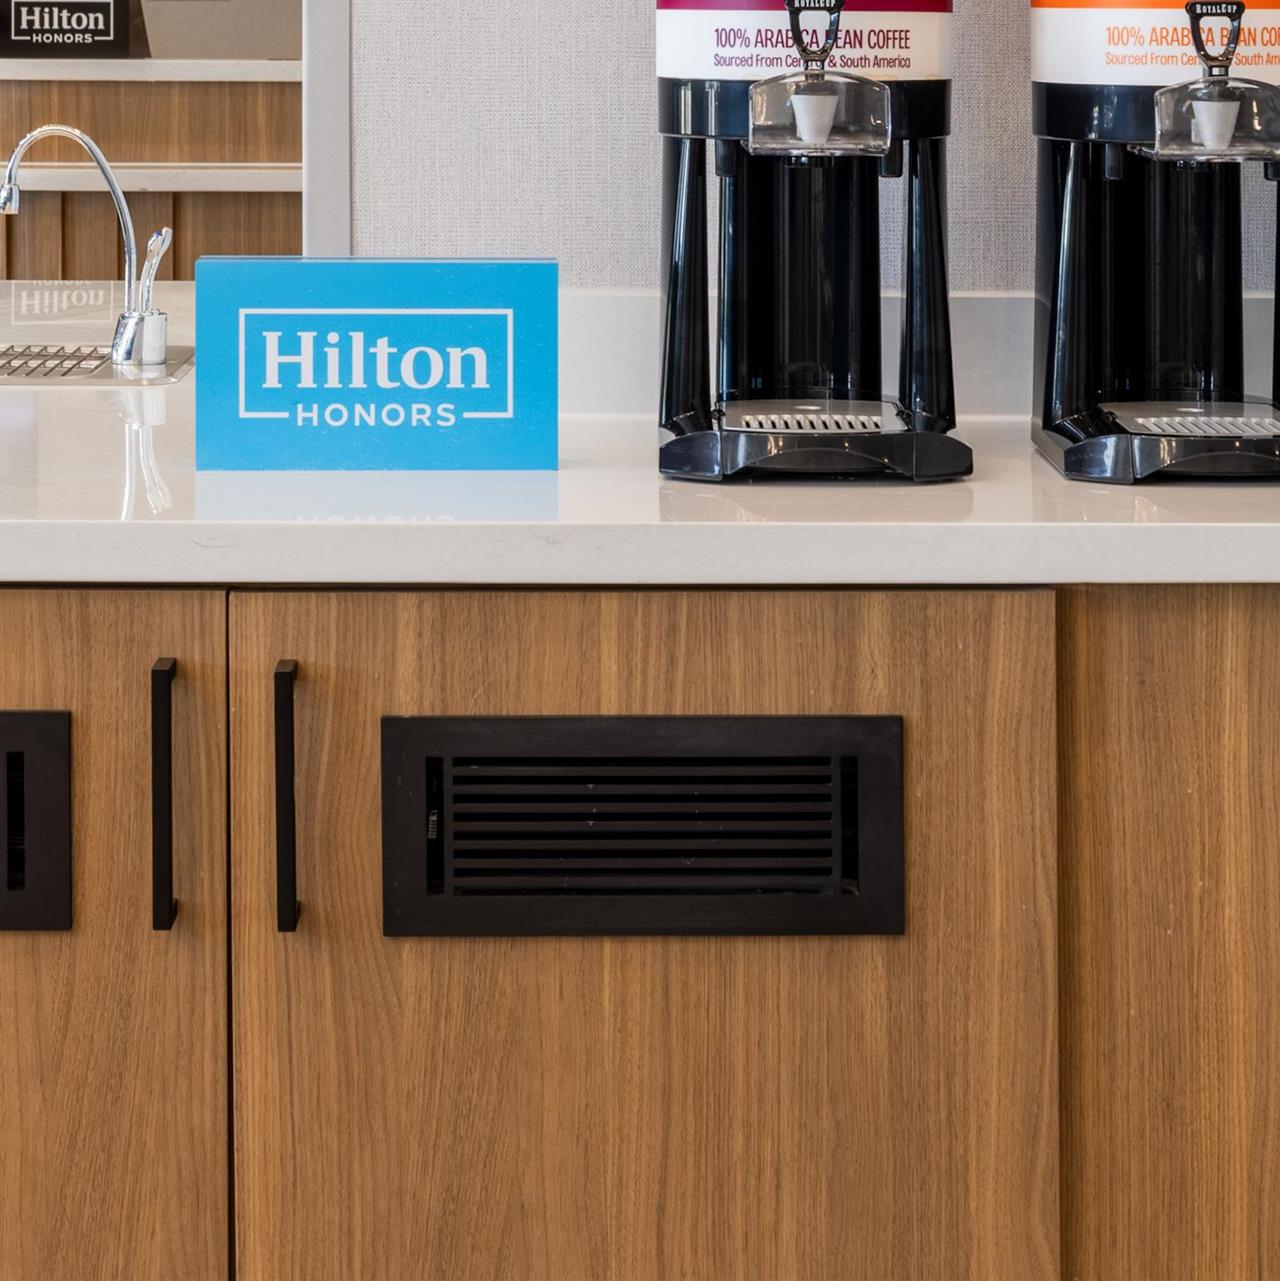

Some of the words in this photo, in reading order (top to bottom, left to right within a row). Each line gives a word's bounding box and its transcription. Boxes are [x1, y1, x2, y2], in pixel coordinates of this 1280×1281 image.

[19, 6, 106, 30] Hilton
[32, 33, 93, 43] HONORS
[713, 27, 751, 48] 100%
[754, 28, 820, 49] ARABCA
[867, 29, 911, 50] COFFEE
[1104, 26, 1145, 47] 100%
[1148, 26, 1215, 47] ARABA
[1220, 27, 1257, 47] BAN
[713, 52, 754, 68] Sourced
[755, 53, 782, 68] From
[827, 54, 837, 68] &
[839, 53, 871, 68] South
[872, 54, 911, 69] America
[1105, 51, 1148, 66] Sourced
[1150, 51, 1178, 66] From
[1235, 52, 1264, 67] South
[261, 330, 491, 390] Hilton
[296, 402, 457, 427] HONORS
